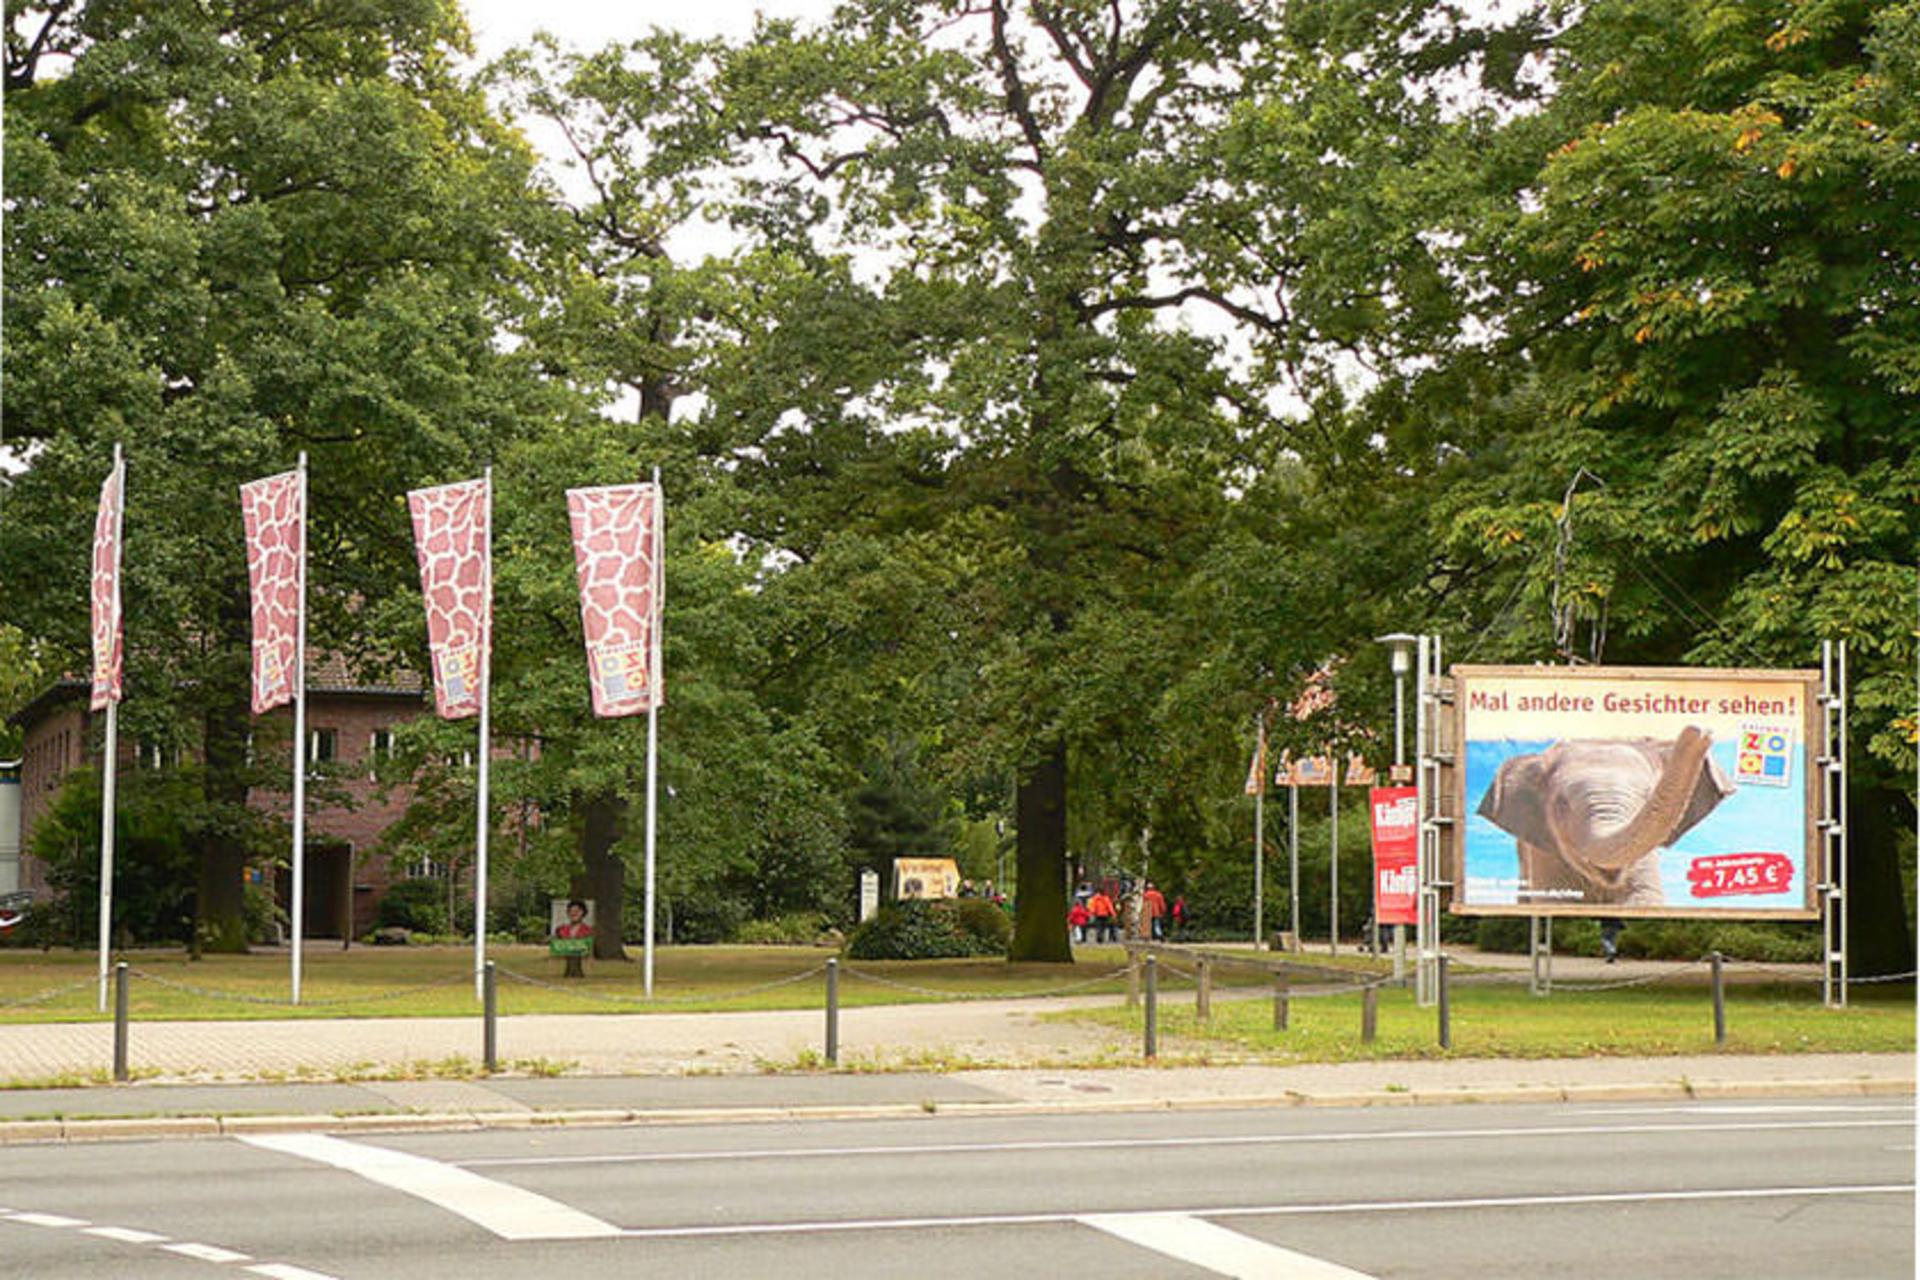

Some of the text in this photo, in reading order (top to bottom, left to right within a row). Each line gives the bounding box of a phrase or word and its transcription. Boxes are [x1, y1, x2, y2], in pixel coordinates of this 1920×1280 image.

[1470, 690, 1795, 716] Mal andere Gesichter sehen!
[1714, 867, 1759, 889] 7,45
